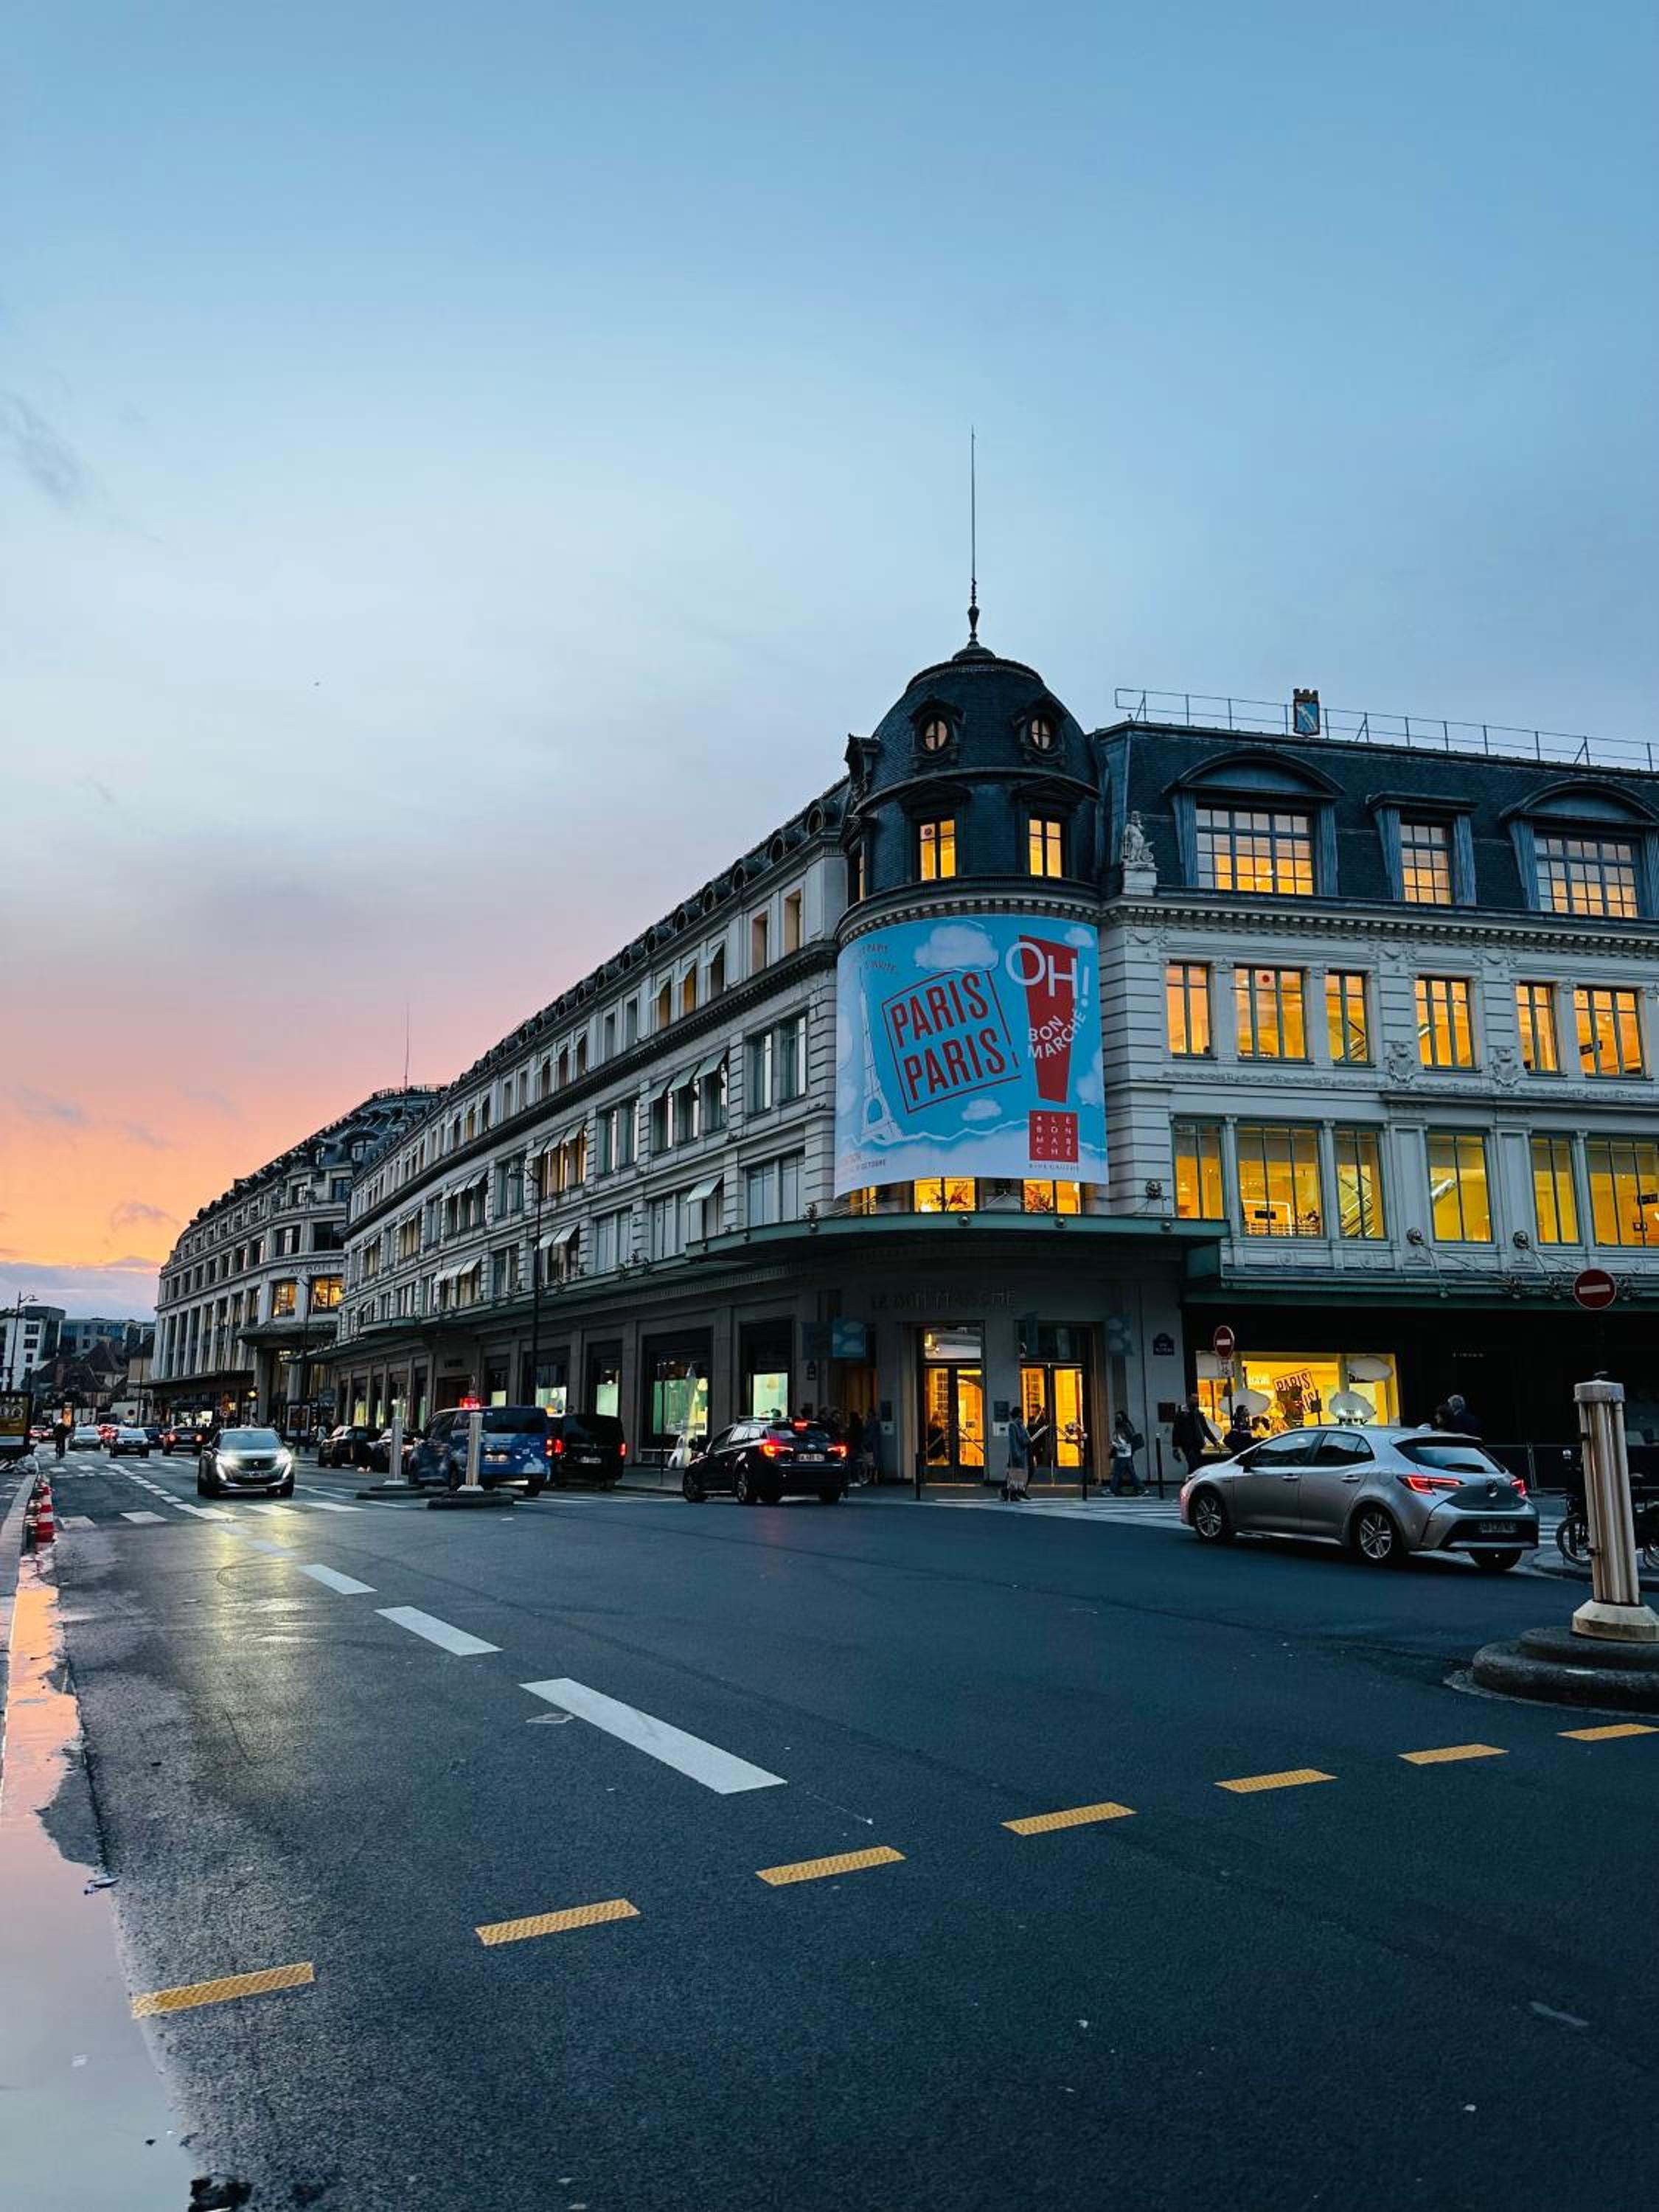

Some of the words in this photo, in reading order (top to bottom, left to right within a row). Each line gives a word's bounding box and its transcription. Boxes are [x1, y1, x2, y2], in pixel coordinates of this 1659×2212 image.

[1005, 942, 1090, 1007] OH!
[891, 972, 989, 1048] PARIS
[1028, 1015, 1064, 1043] BON
[903, 1028, 1006, 1102] PARIS
